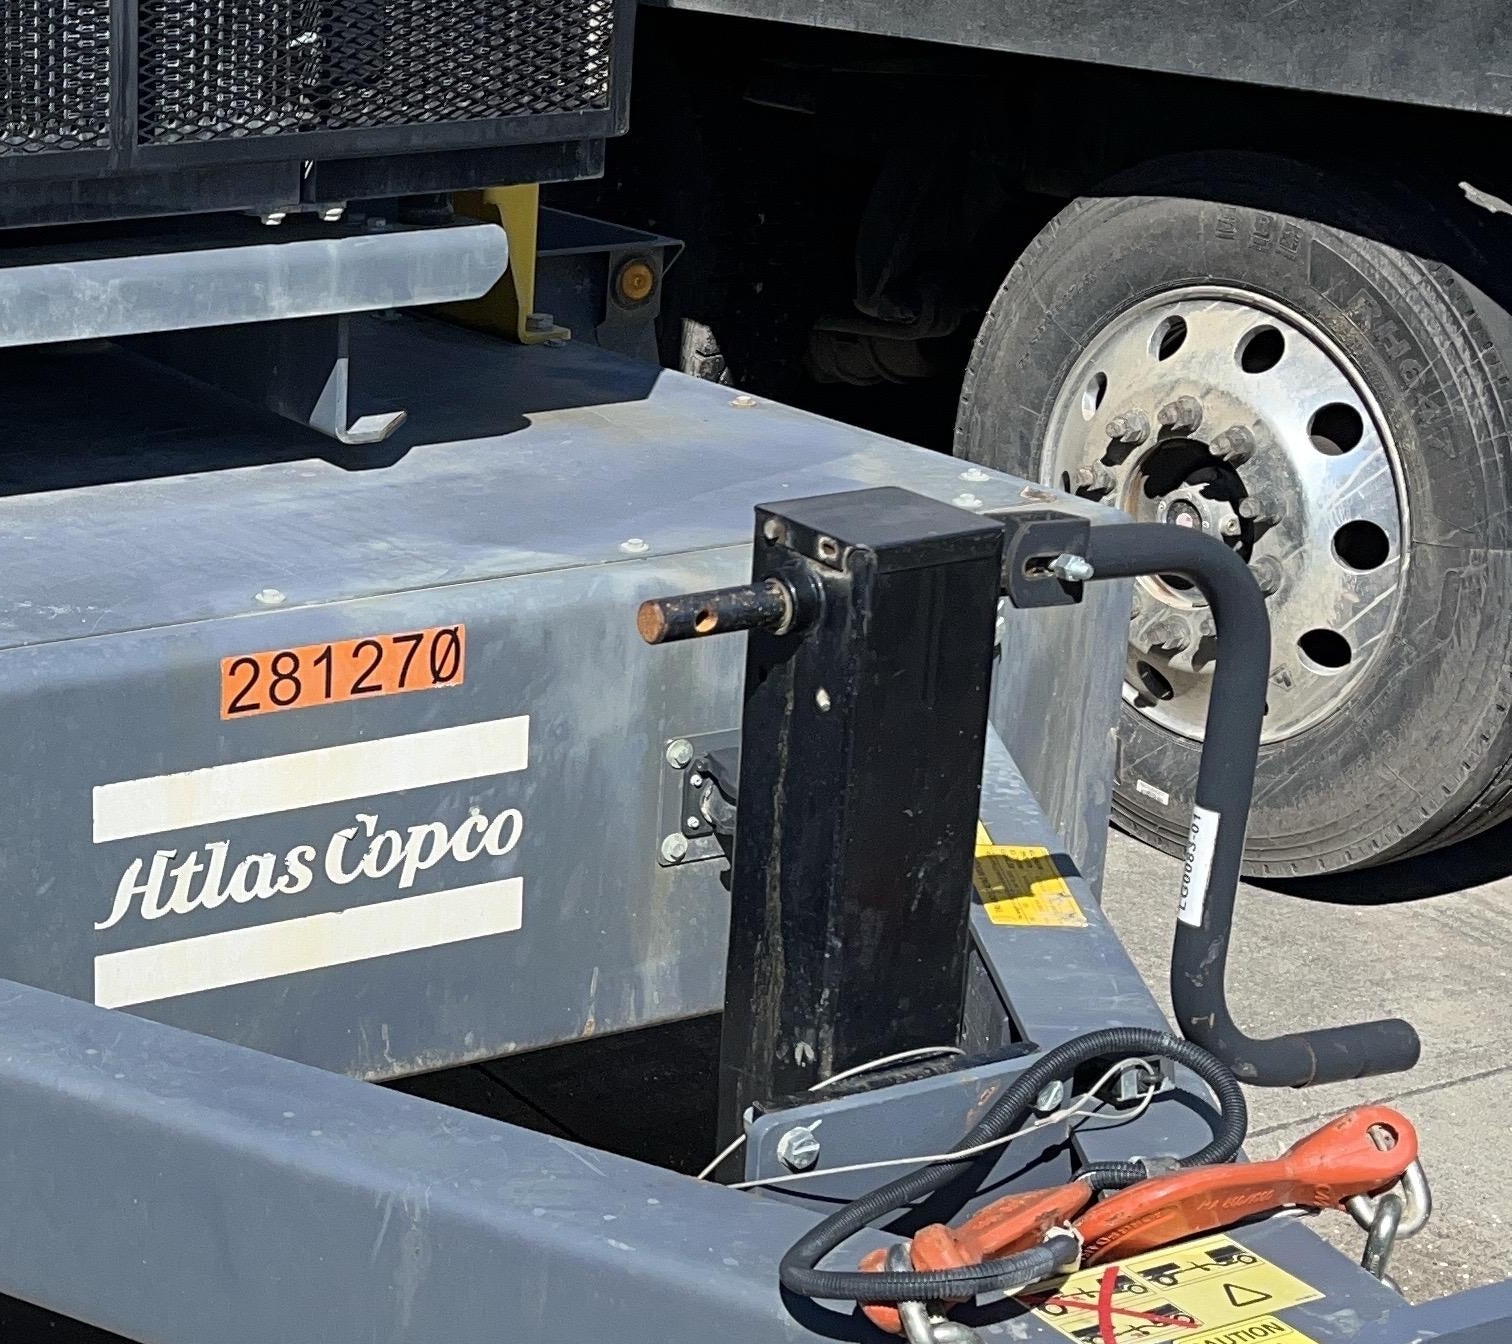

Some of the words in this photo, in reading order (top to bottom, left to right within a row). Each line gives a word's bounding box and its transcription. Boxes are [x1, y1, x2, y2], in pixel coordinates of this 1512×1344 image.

[226, 625, 462, 715] 281270
[94, 839, 315, 931] Atlas
[324, 808, 524, 889] Copco
